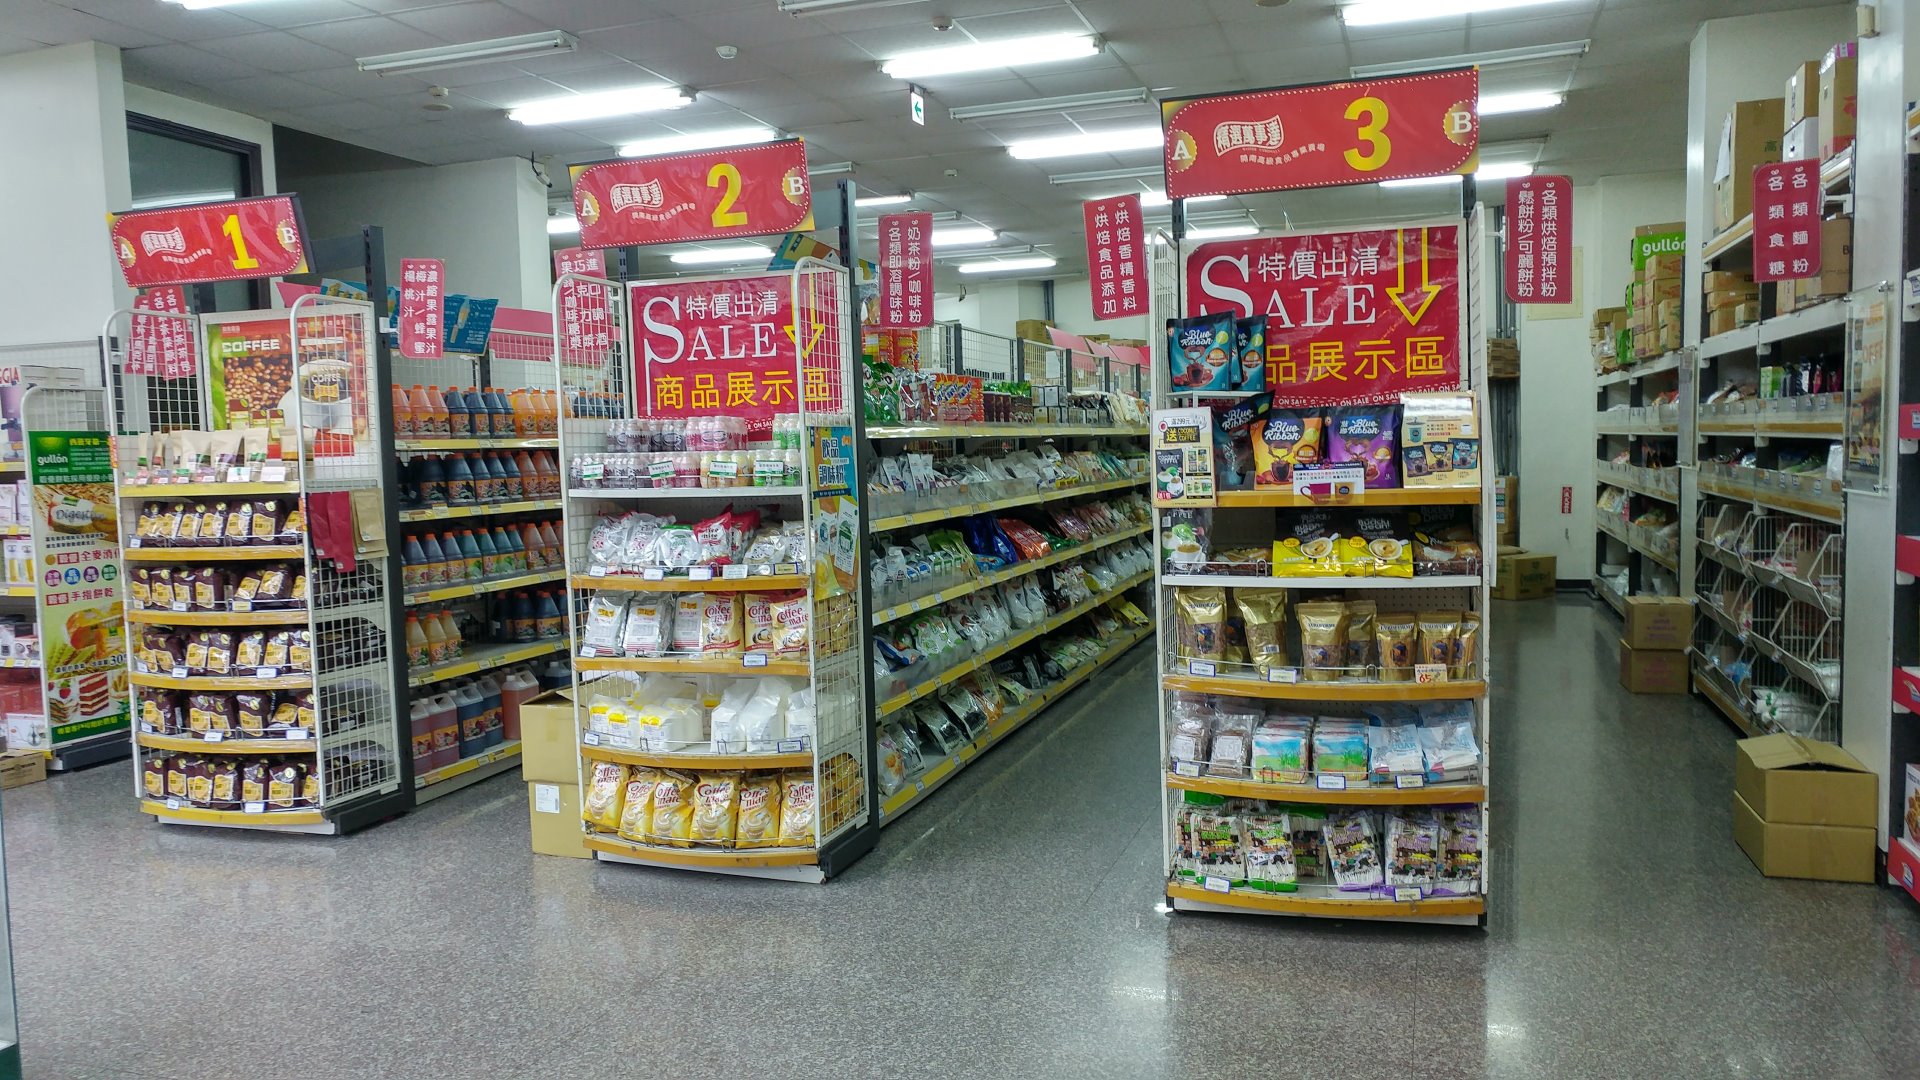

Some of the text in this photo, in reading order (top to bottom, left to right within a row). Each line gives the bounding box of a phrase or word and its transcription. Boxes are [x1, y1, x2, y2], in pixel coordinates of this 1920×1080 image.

[1343, 96, 1391, 171] 3
[1451, 111, 1473, 134] B
[1172, 139, 1192, 161] A
[706, 162, 748, 229] 2
[787, 176, 805, 196] B
[580, 199, 596, 217] A
[1767, 174, 1785, 276] 各類食糖
[1792, 172, 1809, 274] 各類麵粉
[222, 214, 259, 270] 1
[281, 227, 297, 244] B
[1518, 190, 1534, 297] 鬆餅粉/可麗餅粉
[1541, 189, 1557, 298] 各類烘焙預拌粉
[120, 244, 133, 259] A
[1114, 209, 1137, 312] 烘焙香精香料
[907, 226, 922, 323] 奶茶粉/咖啡粉
[1094, 212, 1117, 315] 烘焙食品添加
[1257, 245, 1379, 283] 特價出清
[888, 227, 903, 324] 各類即溶調味粉
[1199, 254, 1376, 329] SALE
[685, 289, 779, 321] 特價出清
[642, 296, 778, 364] SALE
[1185, 329, 1212, 340] Blue
[221, 338, 281, 353] COFFEE
[1265, 336, 1446, 385] 品展示區
[0, 367, 20, 384] GIA
[654, 367, 831, 410] 商品展示區
[1373, 395, 1384, 403] ON
[1352, 397, 1369, 405] SALE
[763, 420, 774, 428] SAL
[1269, 420, 1300, 434] Blue
[1348, 425, 1381, 436] Ribbon
[1352, 418, 1378, 430] Blue
[1264, 430, 1303, 442] Ribbon
[37, 453, 69, 466] gullón
[821, 438, 839, 459] 飲品
[819, 464, 845, 486] 調味粉
[705, 605, 731, 618] Coffee
[748, 605, 771, 619] Coffe
[776, 607, 803, 624] Coffee
